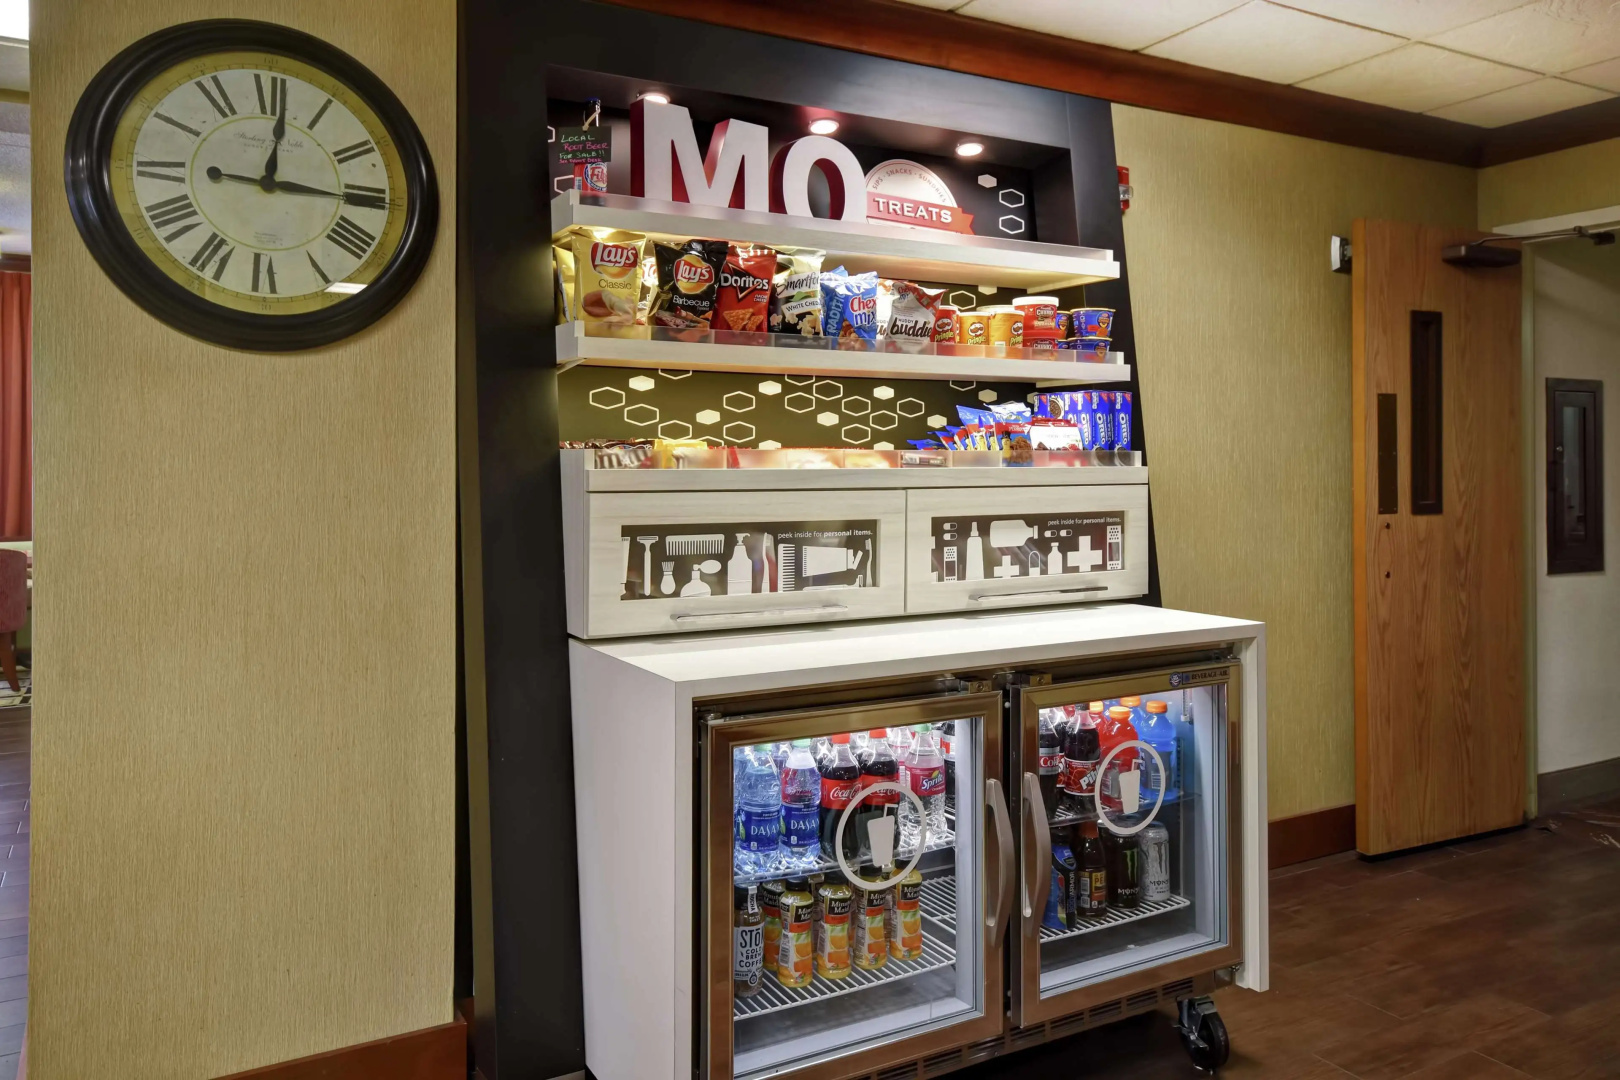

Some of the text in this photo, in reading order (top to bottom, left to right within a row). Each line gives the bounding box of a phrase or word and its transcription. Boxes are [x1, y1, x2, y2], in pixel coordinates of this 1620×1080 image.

[632, 98, 868, 222] MO
[872, 168, 947, 204] SIPS SNACKS SUNDRIES
[873, 197, 953, 224] TREATS
[595, 242, 637, 266] Lay's
[676, 260, 711, 283] Lay's
[720, 273, 769, 290] Doritos
[598, 279, 632, 290] Classic
[672, 294, 710, 307] Barbecue
[850, 296, 877, 313] Chex
[1096, 413, 1106, 445] OREO
[1119, 413, 1128, 445] OREO
[1048, 519, 1060, 527] peek
[1083, 517, 1105, 525] personal
[778, 532, 793, 540] peek
[823, 529, 852, 538] personal
